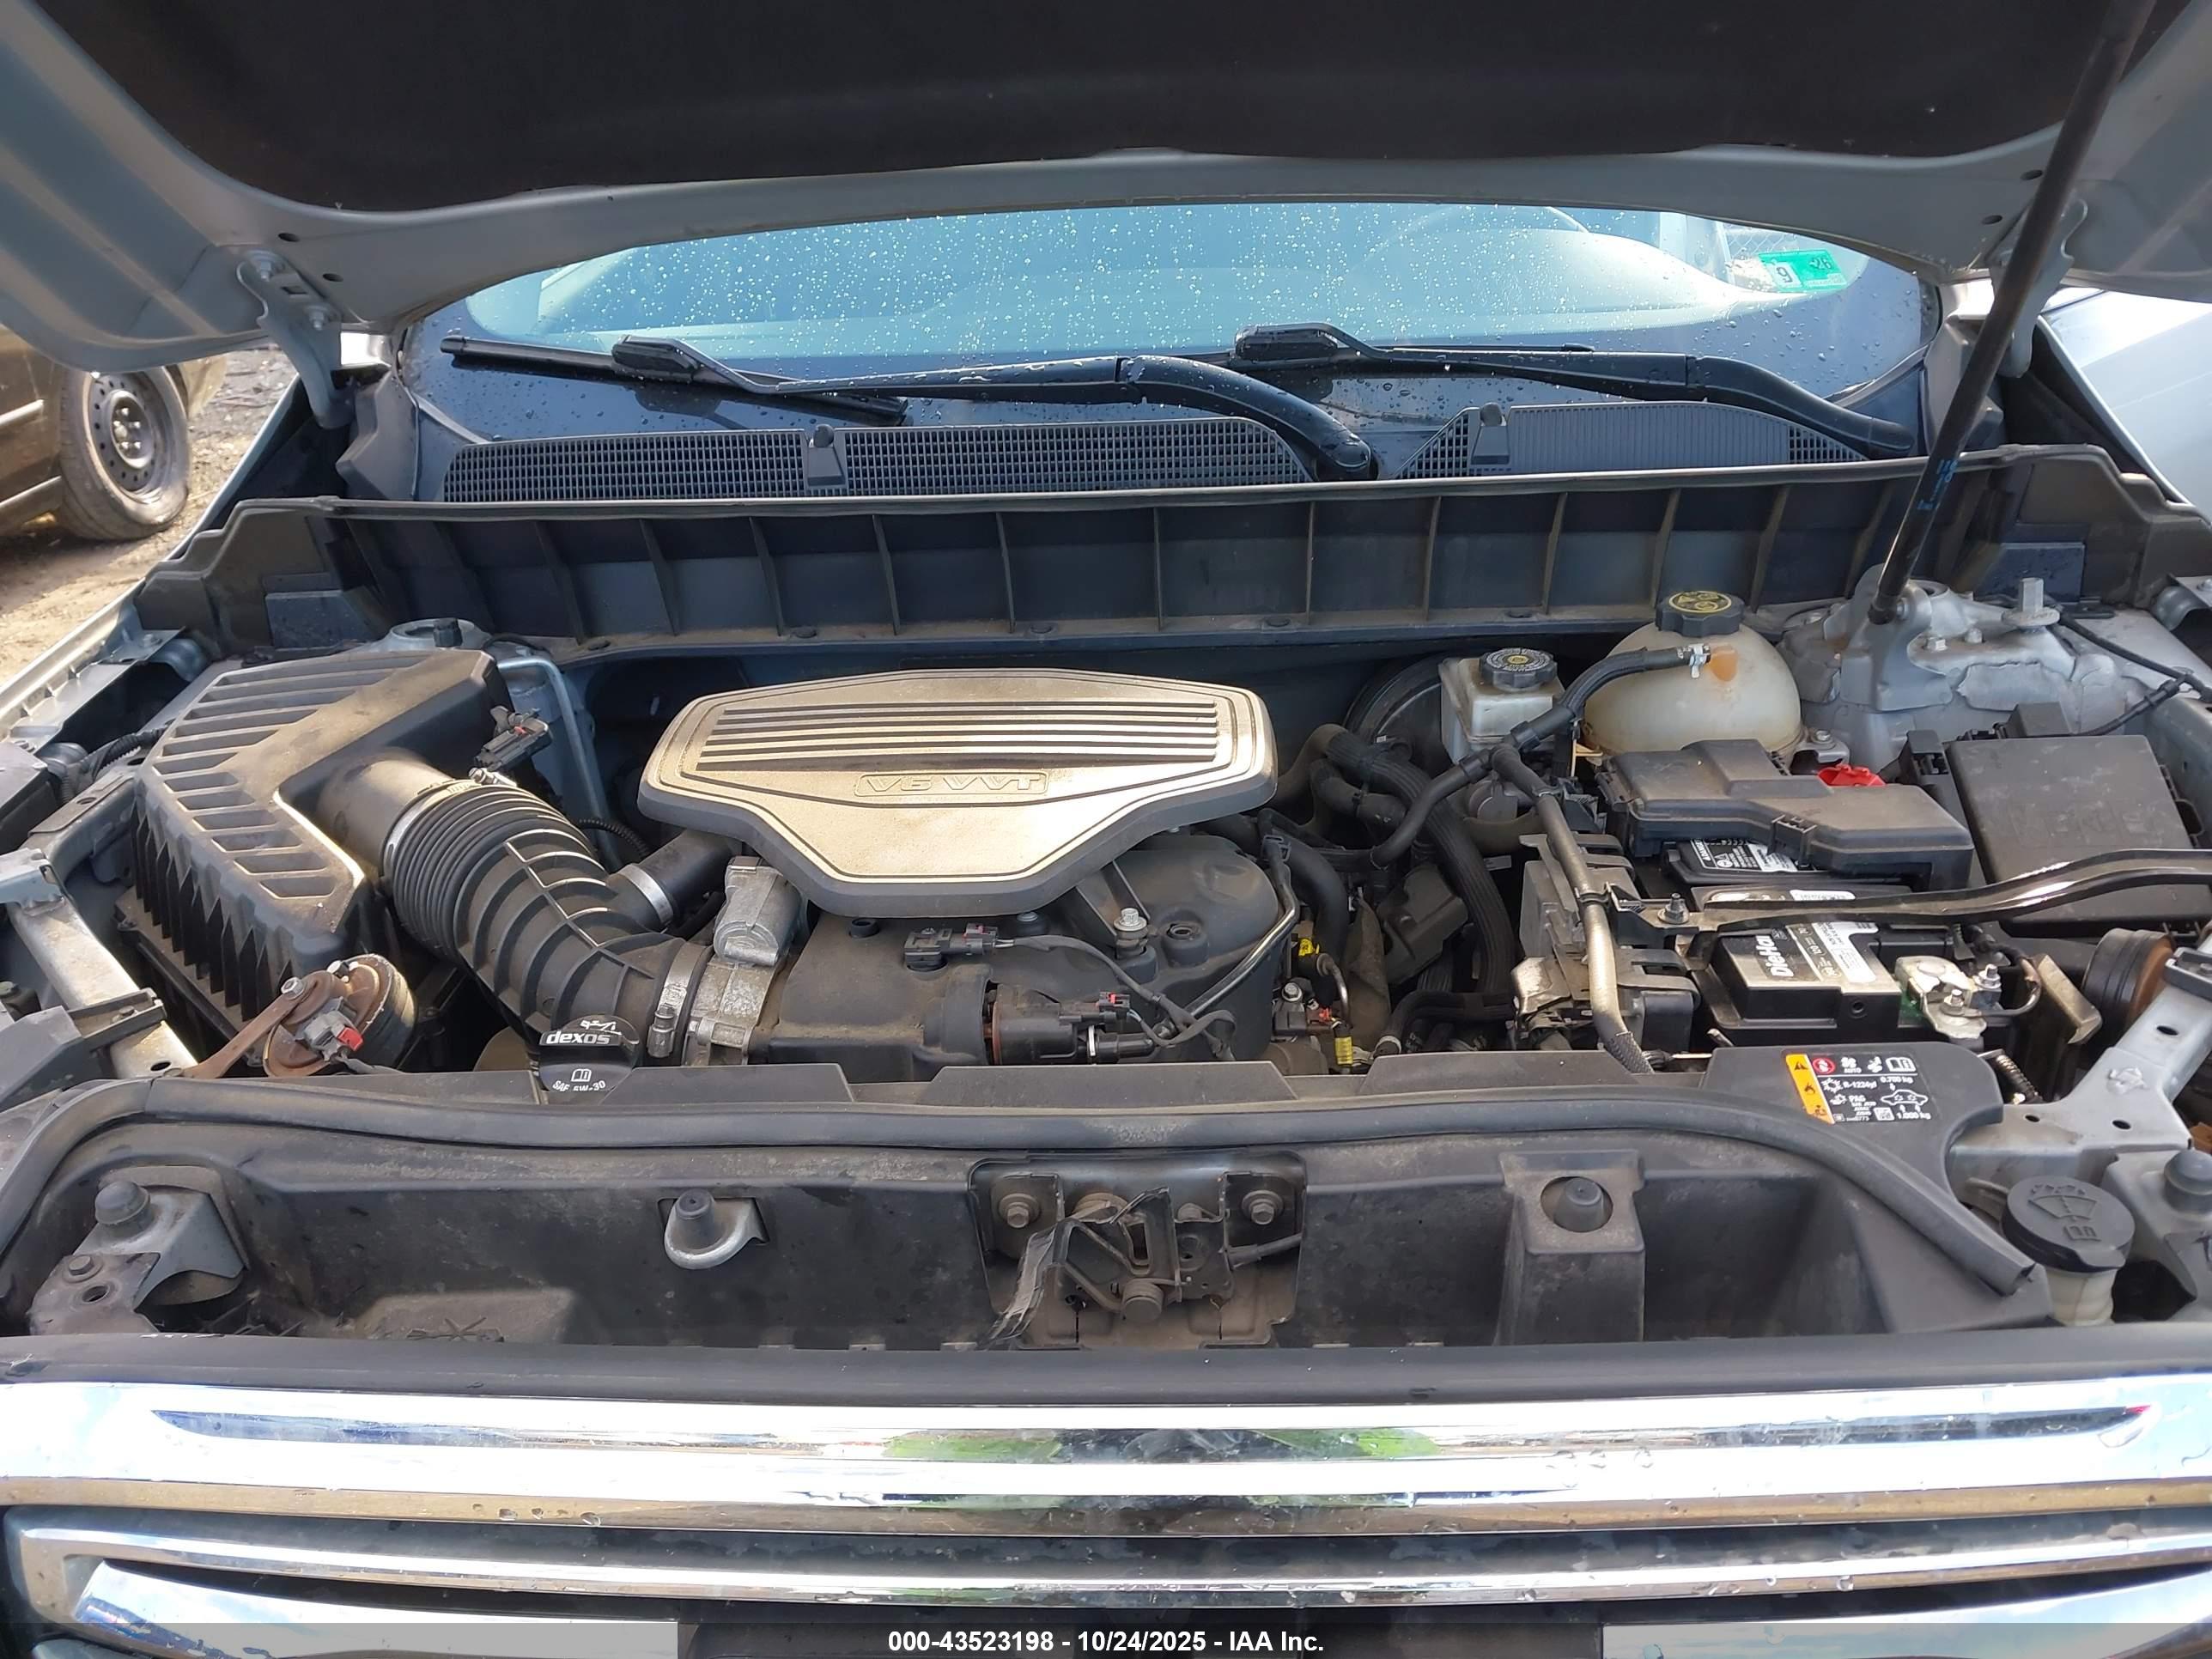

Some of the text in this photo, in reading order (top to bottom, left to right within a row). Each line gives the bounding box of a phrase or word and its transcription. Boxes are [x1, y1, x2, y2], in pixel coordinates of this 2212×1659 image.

[866, 775, 1040, 792] V6 VVT
[546, 1030, 611, 1045] dexos
